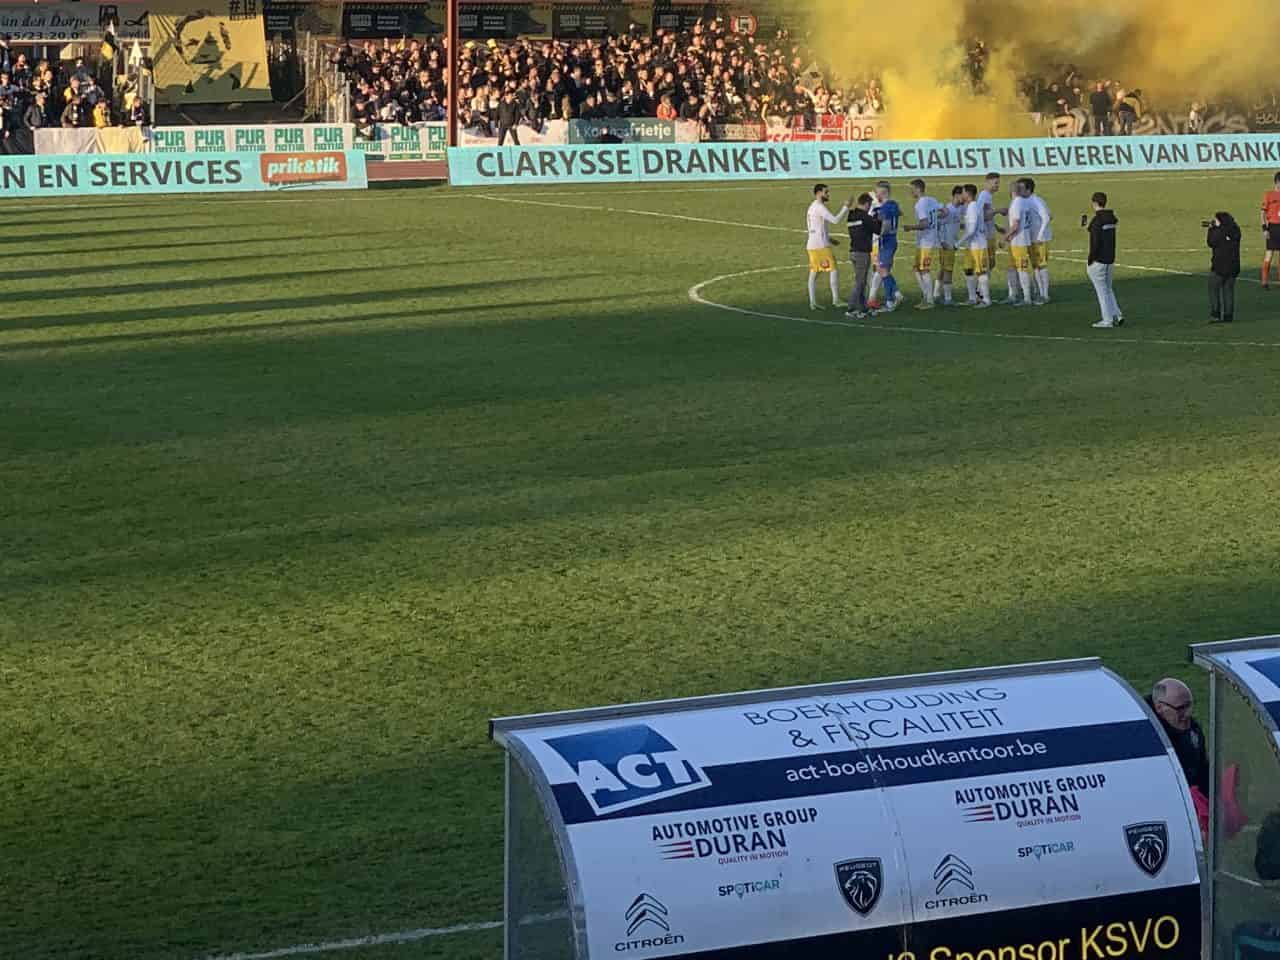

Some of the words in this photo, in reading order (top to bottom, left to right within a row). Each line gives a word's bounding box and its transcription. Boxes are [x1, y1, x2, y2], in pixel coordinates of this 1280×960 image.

[155, 130, 185, 146] PUR
[194, 130, 225, 145] PUR
[235, 129, 265, 145] PUR
[274, 128, 304, 144] PUR
[313, 127, 343, 143] PUR
[0, 164, 26, 189] N
[38, 163, 79, 188] EN
[90, 159, 243, 188] SERVICES
[475, 149, 632, 178] CLARYSSE
[642, 146, 791, 175] DRANKEN
[819, 150, 852, 172] DE
[859, 147, 991, 171] SPECIALIST
[1000, 147, 1025, 169] IN
[1032, 144, 1134, 167] LEVEREN
[1139, 142, 1189, 165] VAN
[744, 686, 1007, 726] BOEKHOUDING
[788, 729, 817, 749] &
[822, 707, 1005, 744] FISCALITEIT
[577, 750, 699, 795] ACT
[785, 739, 1048, 783] act-boekhoudkantoor.be
[955, 780, 1051, 805] AUTOMOTIVE
[1056, 773, 1107, 792] GROUP
[994, 794, 1080, 821] DURAN
[652, 814, 760, 840] AUTOMOTIVE
[763, 807, 819, 827] GROUP
[695, 828, 788, 858] DURAN
[718, 879, 780, 899] SPOTICAR
[1080, 915, 1180, 958] KSVO
